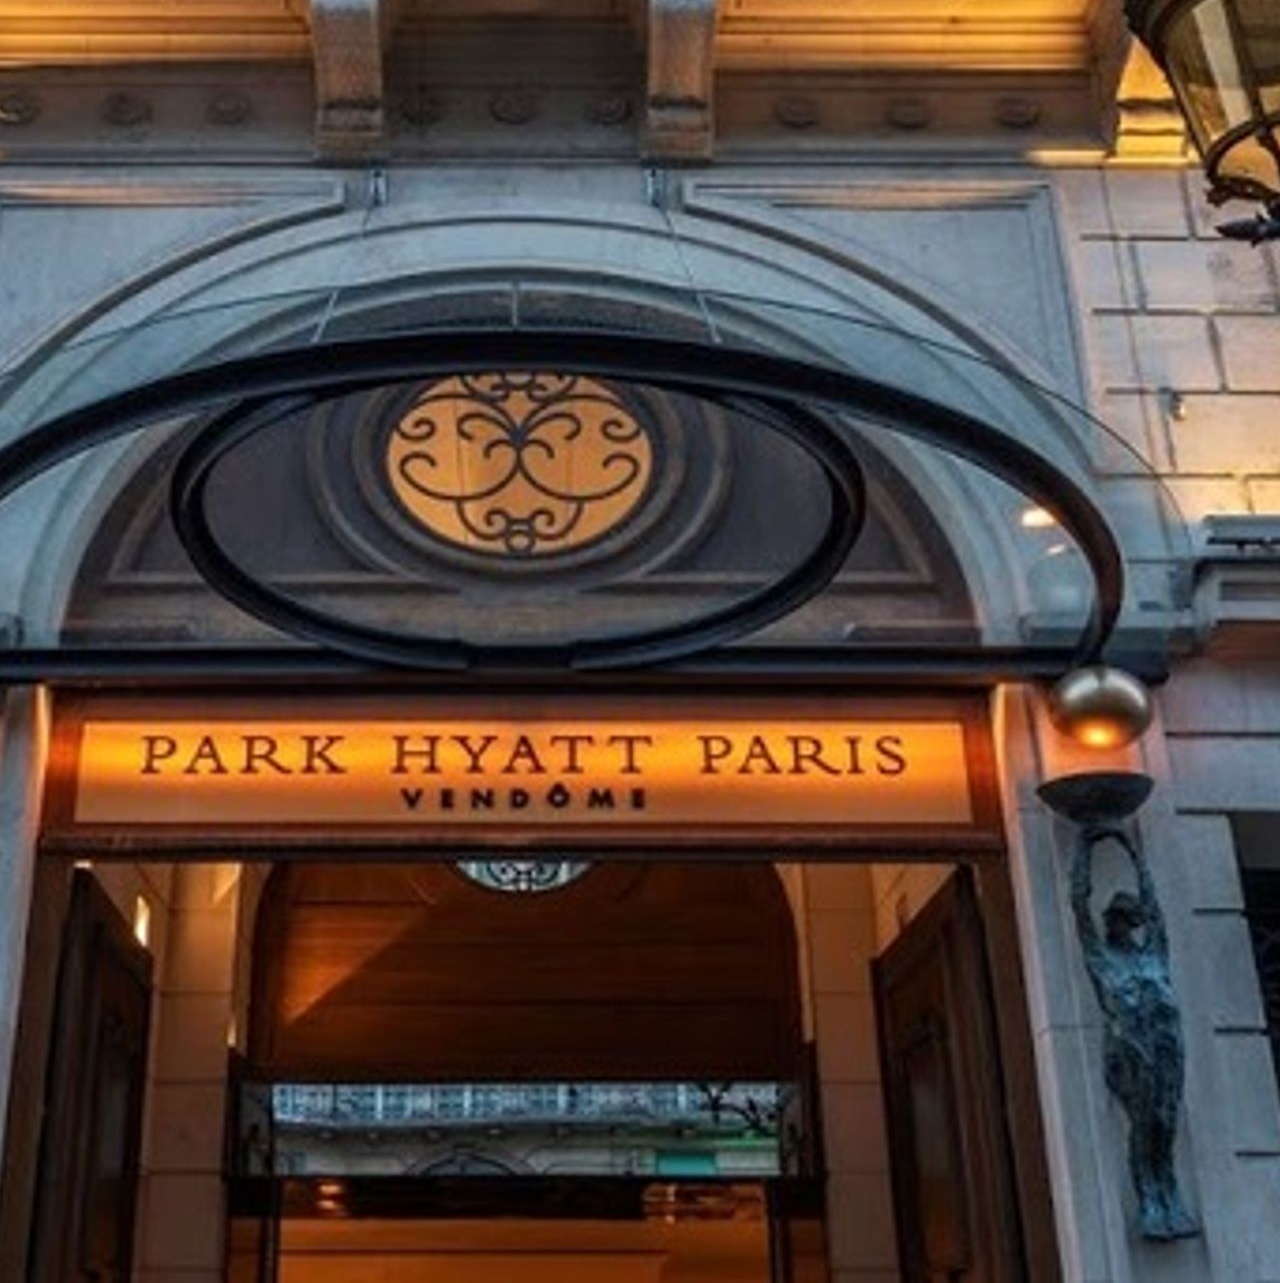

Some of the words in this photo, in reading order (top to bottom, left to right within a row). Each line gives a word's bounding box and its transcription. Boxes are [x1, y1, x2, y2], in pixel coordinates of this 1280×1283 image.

[140, 735, 347, 774] PARK
[390, 735, 652, 774] HYATT
[696, 735, 907, 775] PARIS
[400, 783, 646, 810] VENDÔME
